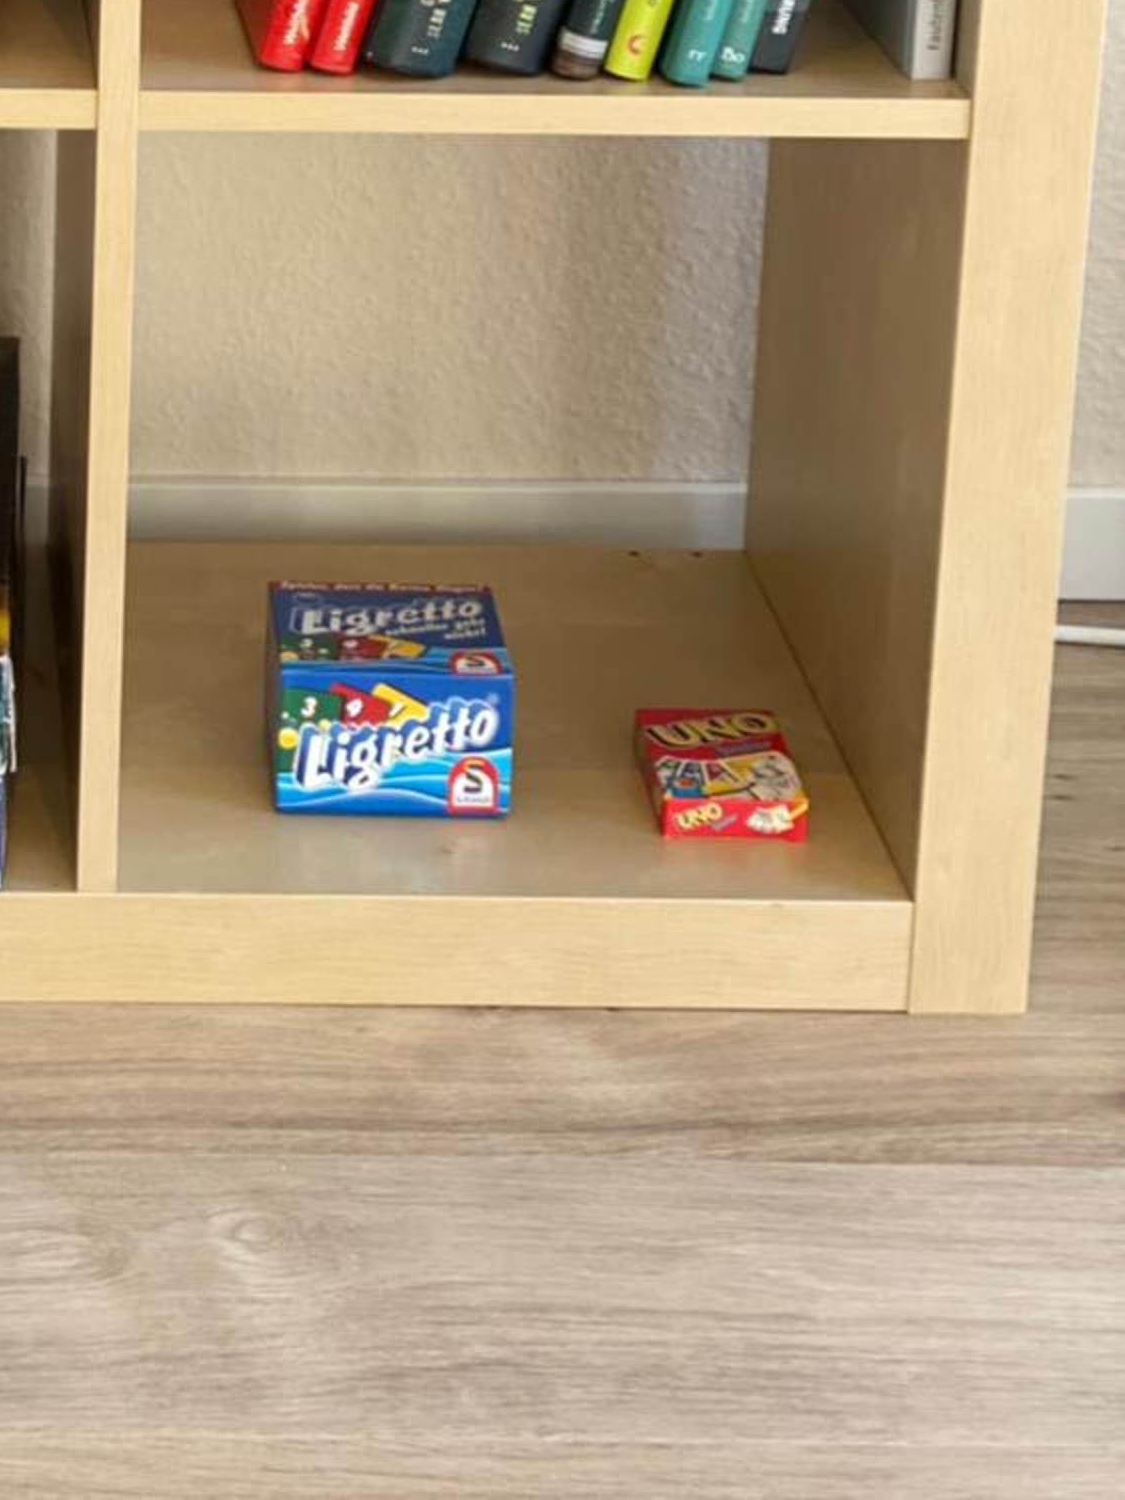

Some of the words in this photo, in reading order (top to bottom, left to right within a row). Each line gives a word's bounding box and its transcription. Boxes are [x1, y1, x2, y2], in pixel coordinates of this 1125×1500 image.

[302, 598, 482, 636] Ligretto
[295, 700, 500, 792] Ligretto
[645, 712, 777, 750] UNO
[677, 802, 723, 829] UNO
